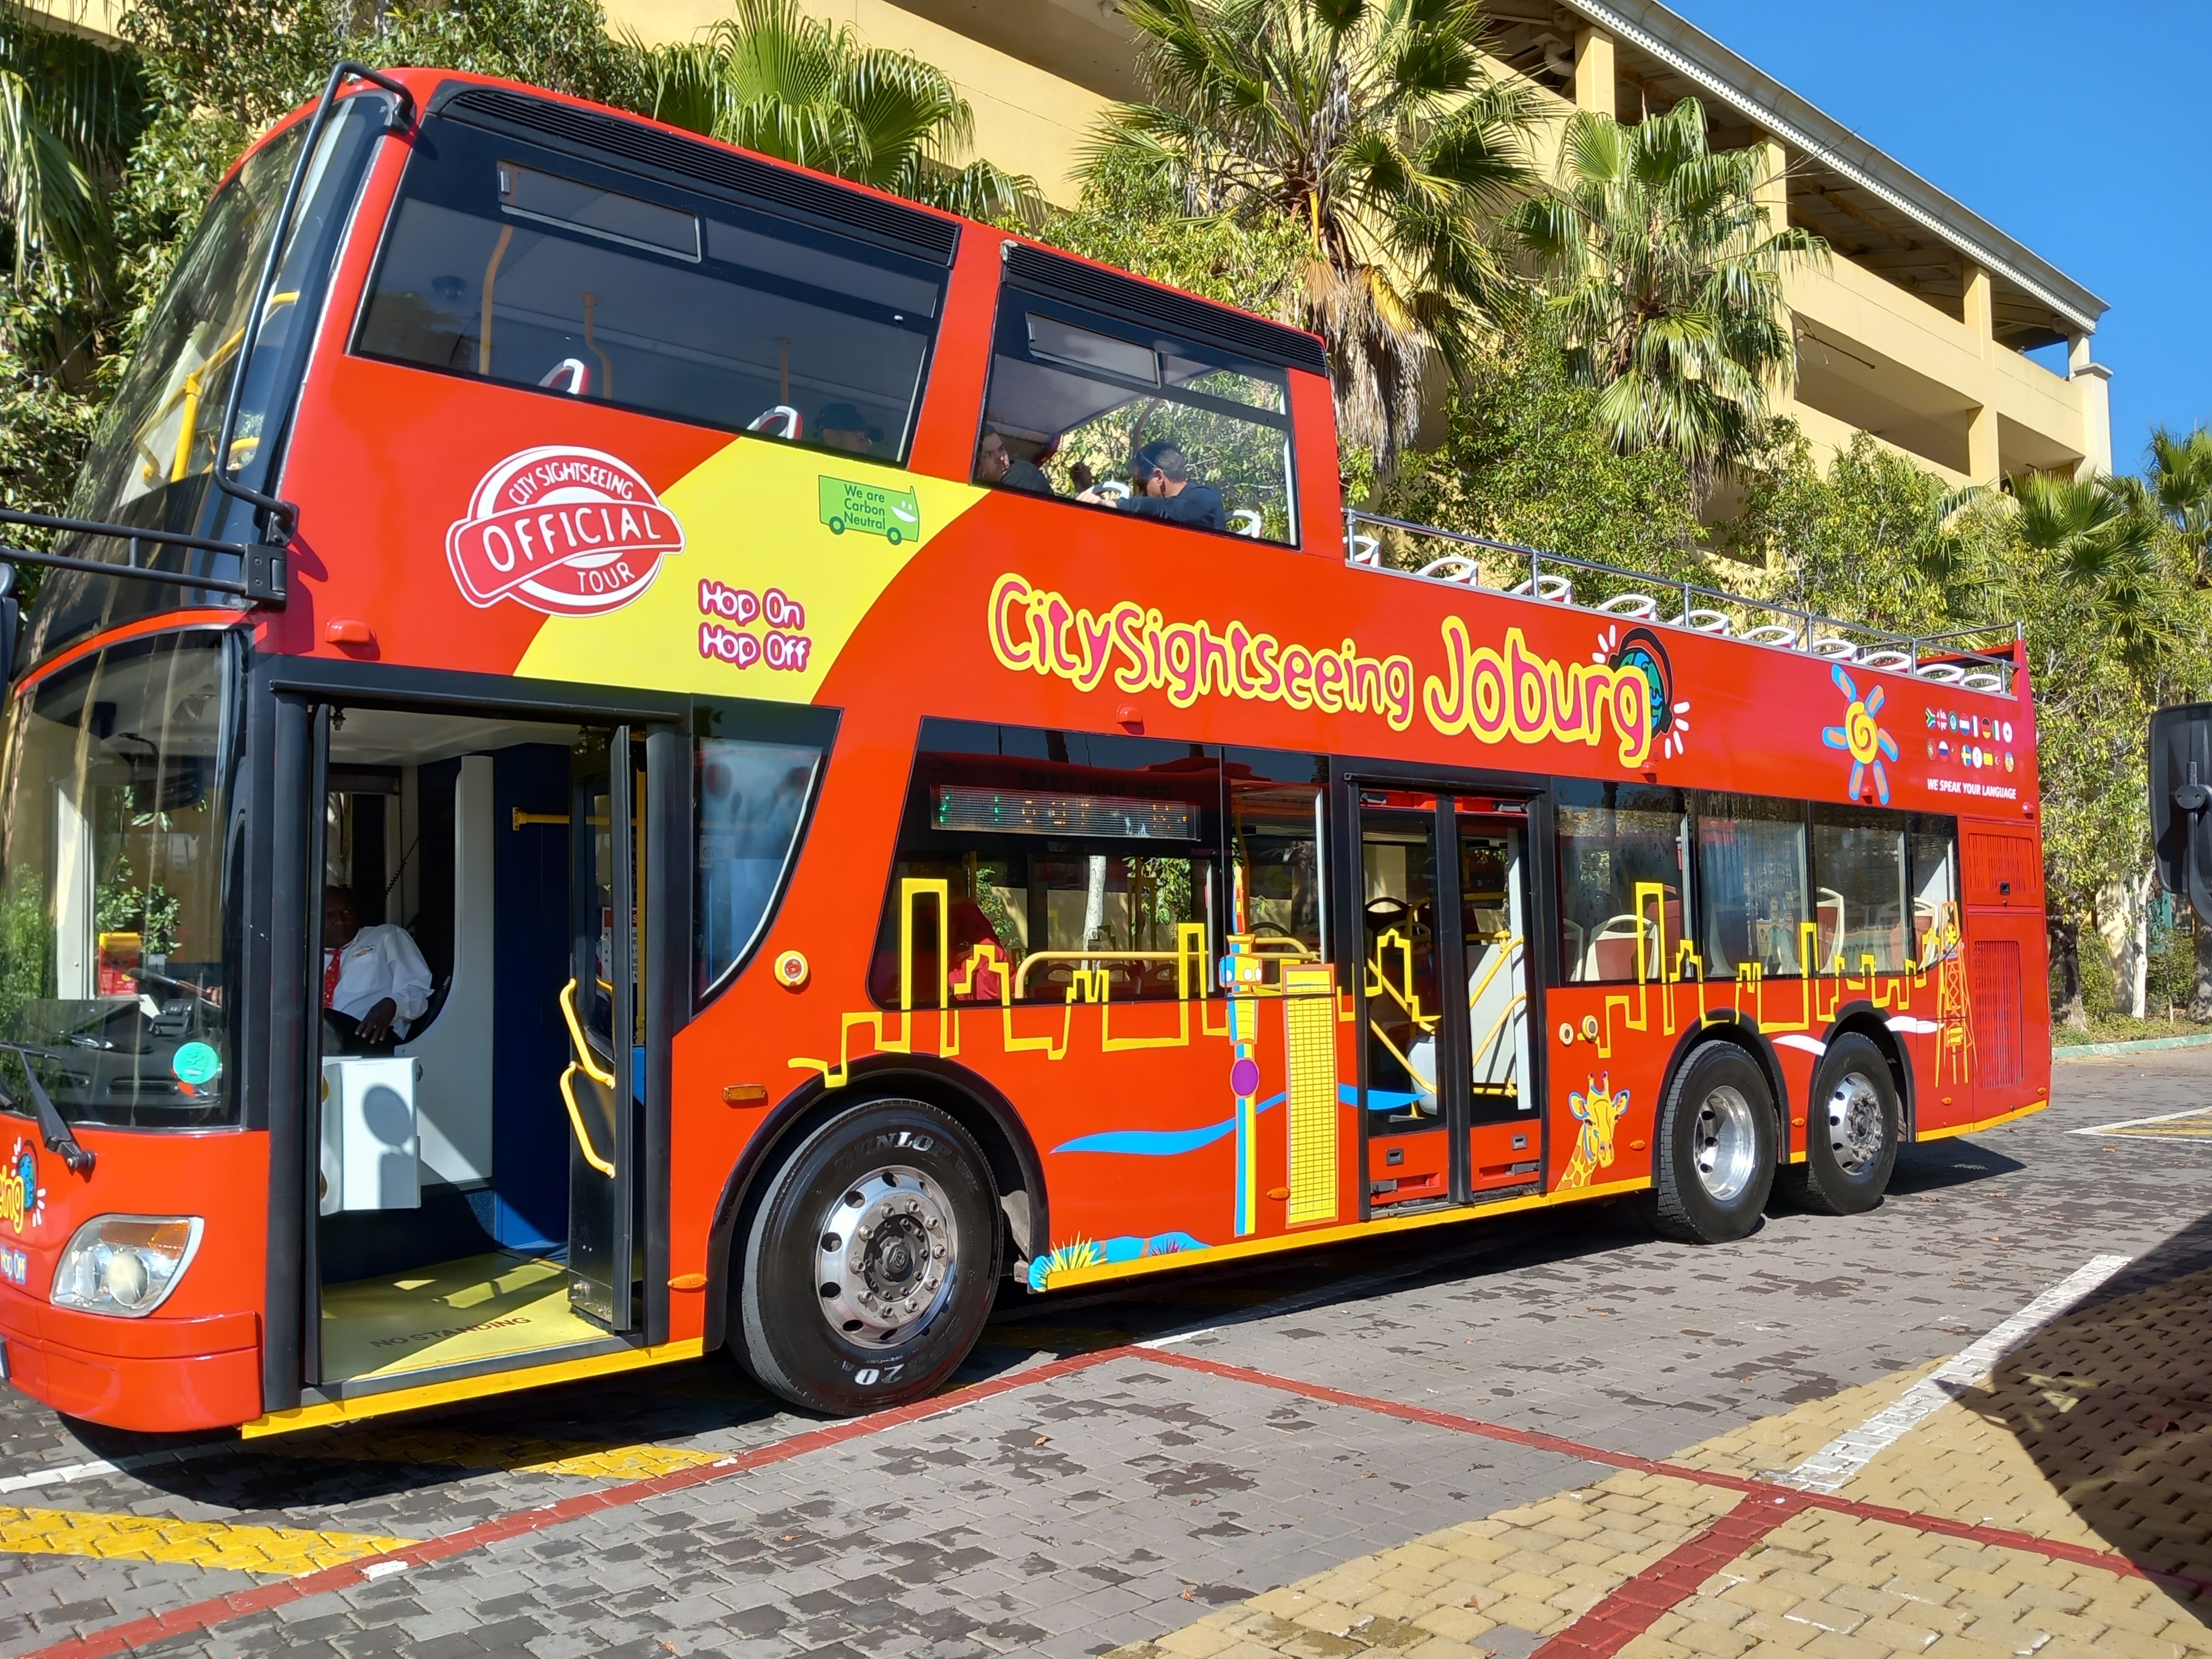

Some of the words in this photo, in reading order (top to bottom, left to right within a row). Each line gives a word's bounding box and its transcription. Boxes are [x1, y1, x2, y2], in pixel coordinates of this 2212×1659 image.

[508, 472, 538, 505] CITY
[535, 462, 634, 500] SIGHTSEEING
[844, 484, 863, 498] We
[866, 492, 885, 503] are
[844, 498, 885, 516] Carbon
[844, 511, 885, 530] Neutral
[483, 507, 661, 573] OFFICIAL
[576, 561, 635, 593] TOUR
[698, 578, 760, 627] Hop
[762, 588, 805, 631] On
[699, 622, 761, 670] Hop
[763, 631, 812, 672] Off
[1423, 615, 1652, 768] Joburg
[1927, 778, 1939, 791] WE
[1939, 780, 1962, 793] SPEAK
[1962, 782, 1981, 795] YOUR
[1982, 785, 2016, 800] LANGUAGE
[834, 1131, 953, 1179] DUNLOP
[369, 1337, 409, 1348] NO
[409, 1317, 531, 1341] STANDING
